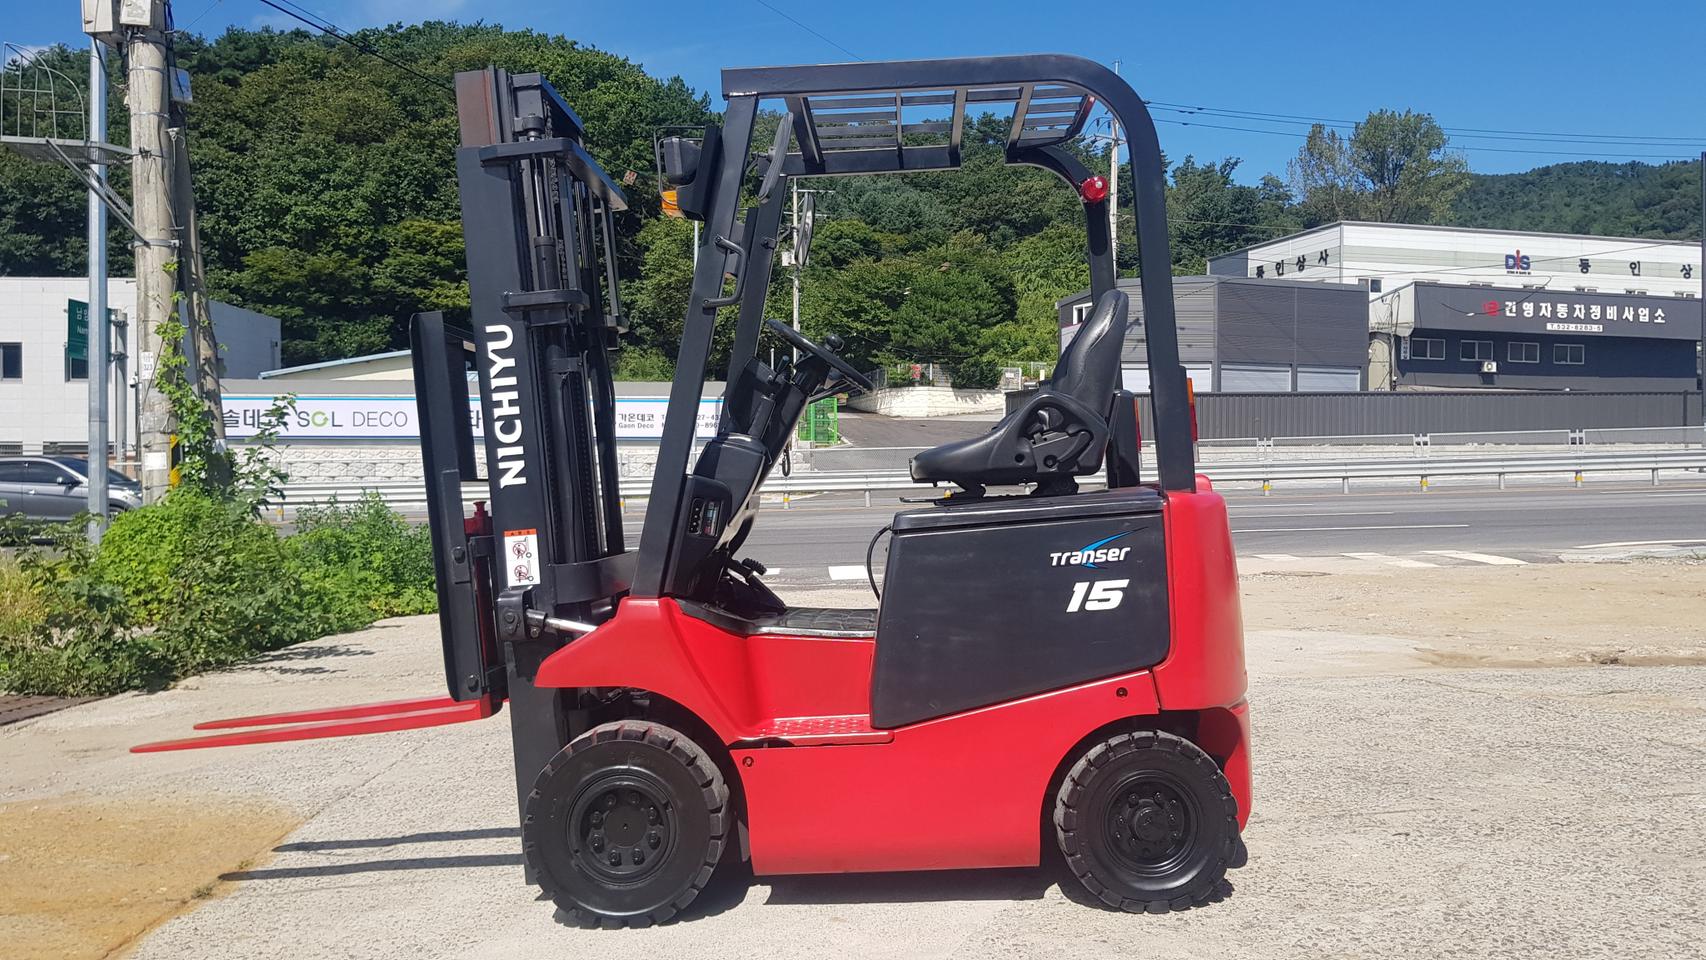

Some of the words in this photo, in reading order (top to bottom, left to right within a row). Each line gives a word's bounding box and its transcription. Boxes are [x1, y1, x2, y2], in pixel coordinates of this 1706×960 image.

[485, 324, 527, 489] NICHIYU
[352, 411, 408, 427] DECO
[618, 413, 655, 422] 가온데코
[1050, 547, 1131, 567] Transer
[1066, 579, 1130, 613] 15
